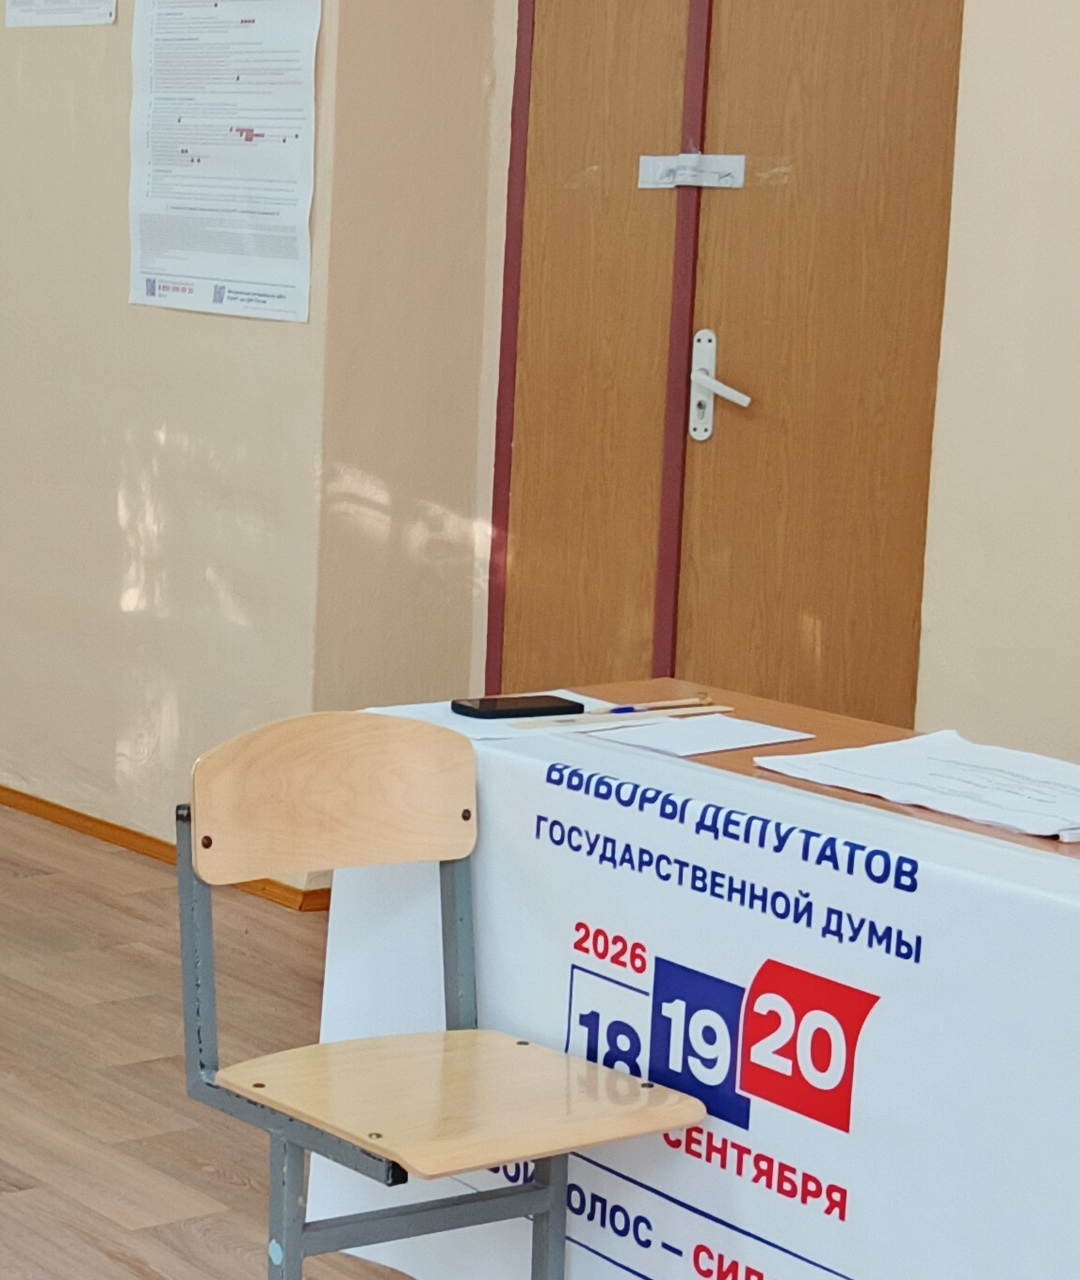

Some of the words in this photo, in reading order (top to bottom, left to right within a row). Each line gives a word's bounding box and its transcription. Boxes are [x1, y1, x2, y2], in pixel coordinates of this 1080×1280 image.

[546, 762, 694, 826] ВЫБОРЫ
[695, 802, 920, 894] ДЕПУТАТОВ
[535, 814, 815, 930] ГОСУДАРСТВЕННОЙ
[821, 905, 924, 965] ДУМЫ
[574, 922, 648, 974] 2026
[578, 1009, 642, 1078] 18
[661, 998, 732, 1086] 19
[750, 992, 847, 1091] 20
[566, 1182, 653, 1249] ОЛОС
